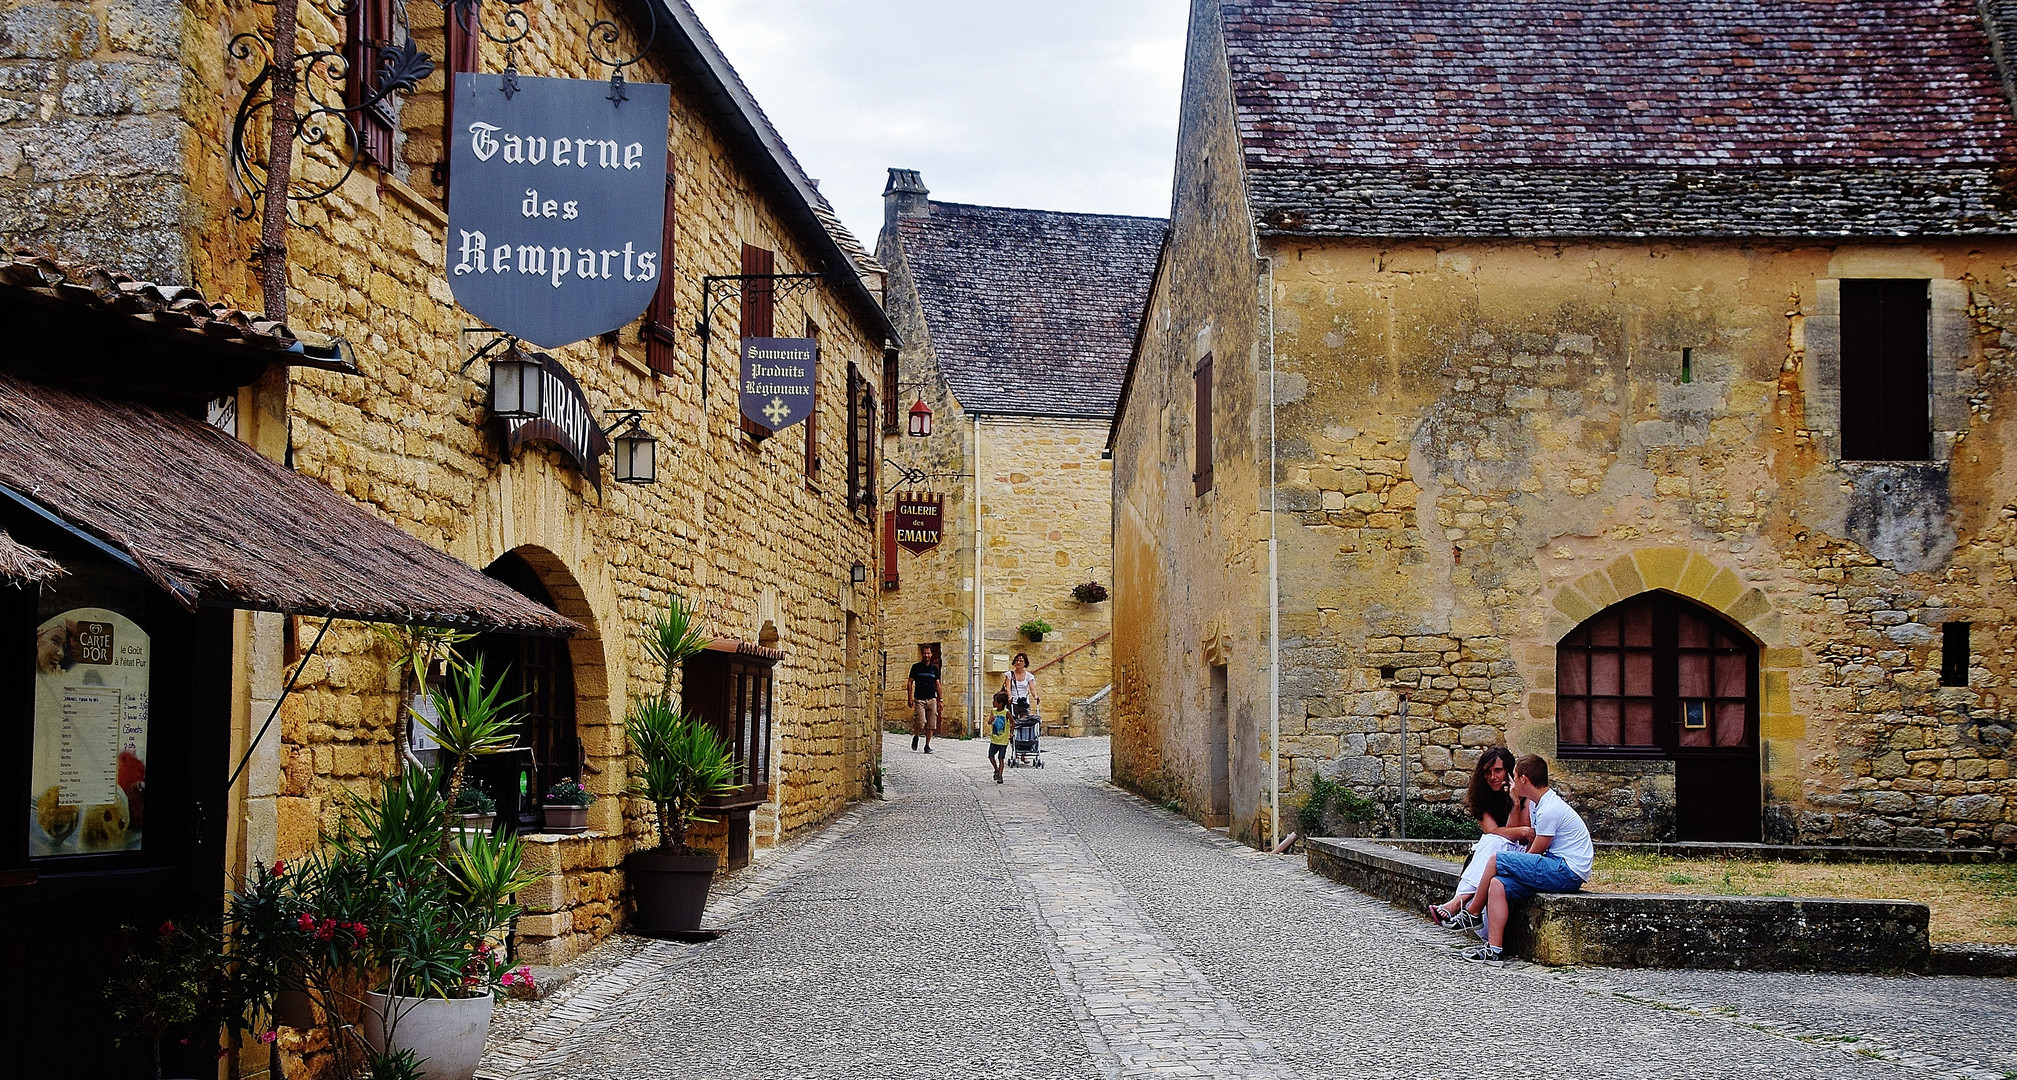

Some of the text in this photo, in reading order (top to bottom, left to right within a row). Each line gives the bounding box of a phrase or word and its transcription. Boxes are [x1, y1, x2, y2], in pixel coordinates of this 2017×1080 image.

[469, 121, 643, 171] Taverne
[521, 188, 579, 220] des
[453, 228, 657, 289] Remparts
[747, 345, 810, 360] Souvenirs
[751, 364, 804, 379] Produits
[745, 381, 809, 397] Régionaux
[509, 370, 591, 459] AURANT
[900, 505, 937, 516] GALERIE
[897, 529, 939, 543] EMAUX
[80, 632, 110, 648] CARTE
[83, 647, 108, 661] D'OR
[120, 645, 143, 655] le Goût
[114, 657, 147, 667] à l'état Pur
